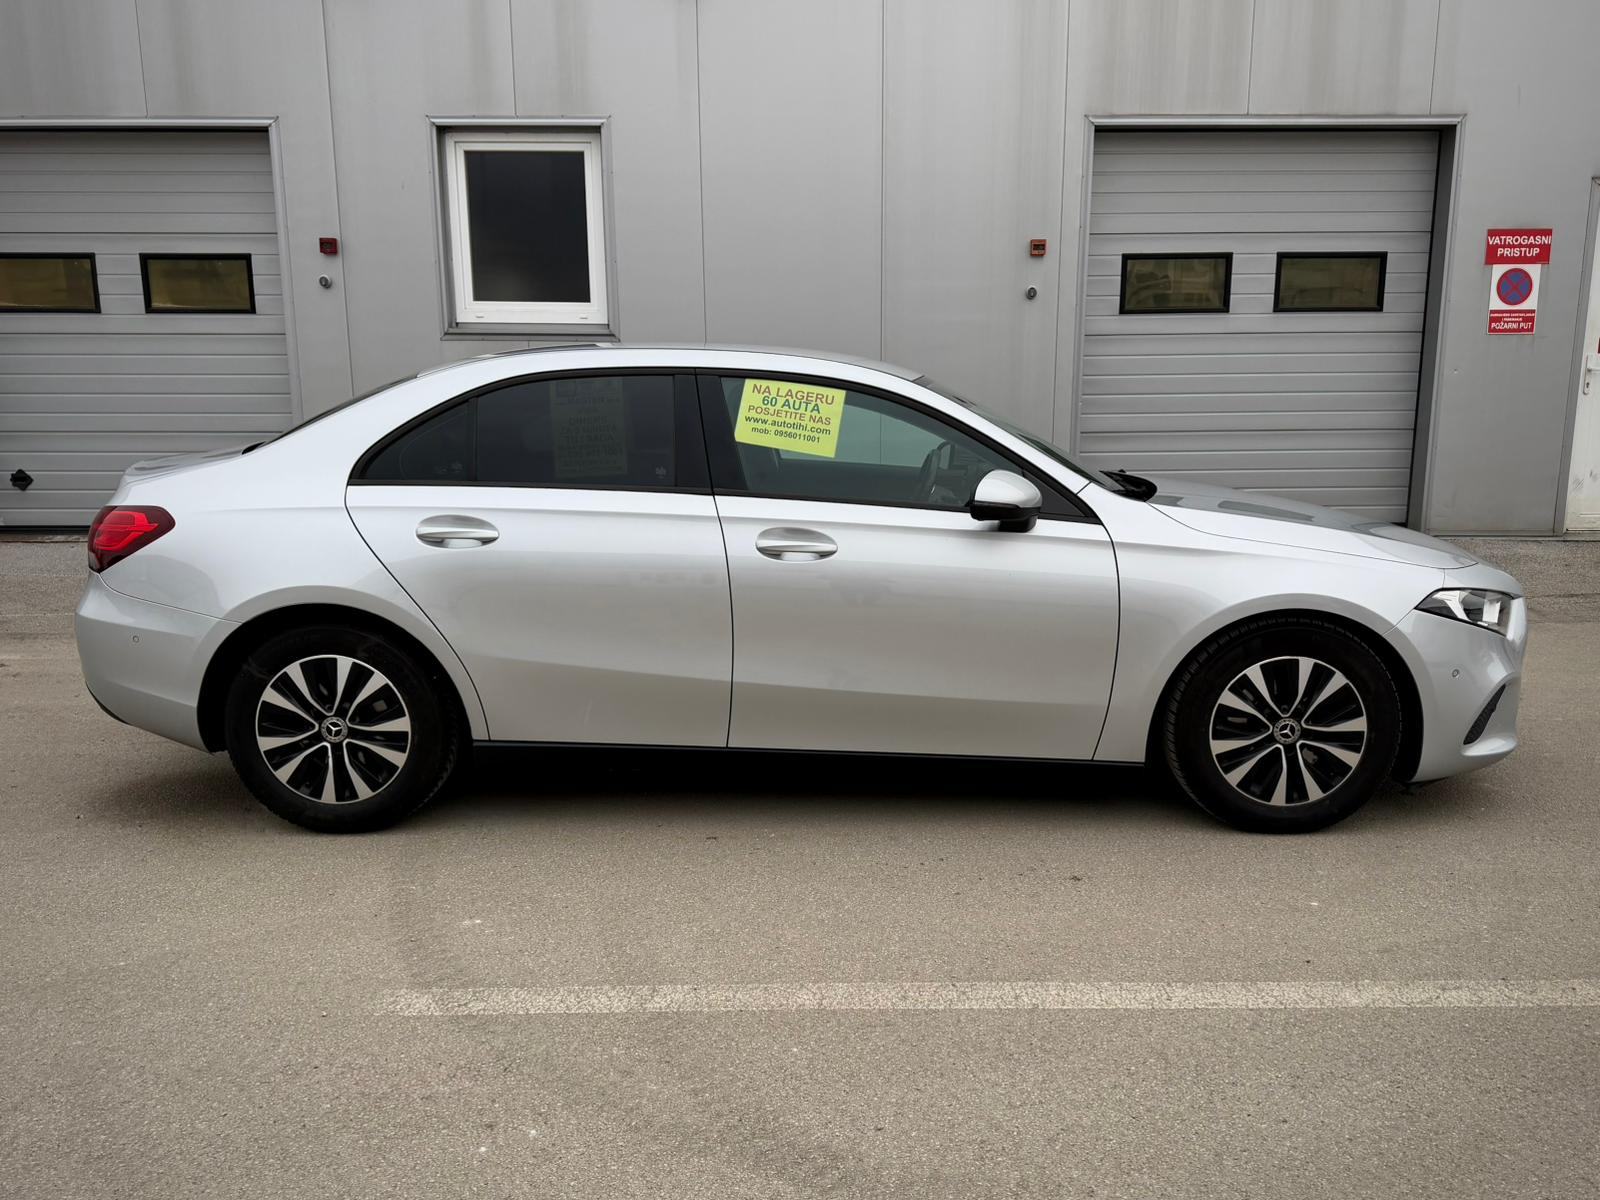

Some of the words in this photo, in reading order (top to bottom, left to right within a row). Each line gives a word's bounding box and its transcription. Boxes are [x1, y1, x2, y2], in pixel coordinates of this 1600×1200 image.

[1488, 235, 1552, 245] VATROGASNI
[1497, 247, 1540, 257] PRISTUP
[1491, 321, 1518, 330] POŽARNI
[752, 383, 772, 396] NA
[776, 387, 835, 405] LAGERU
[762, 395, 778, 407] 60
[781, 398, 821, 414] AUTA
[747, 404, 806, 421] POSJETITE
[809, 414, 831, 426] NAS
[744, 415, 831, 435] www.autotihi.com
[751, 426, 772, 435] mob:
[774, 429, 820, 443] 0956011001
